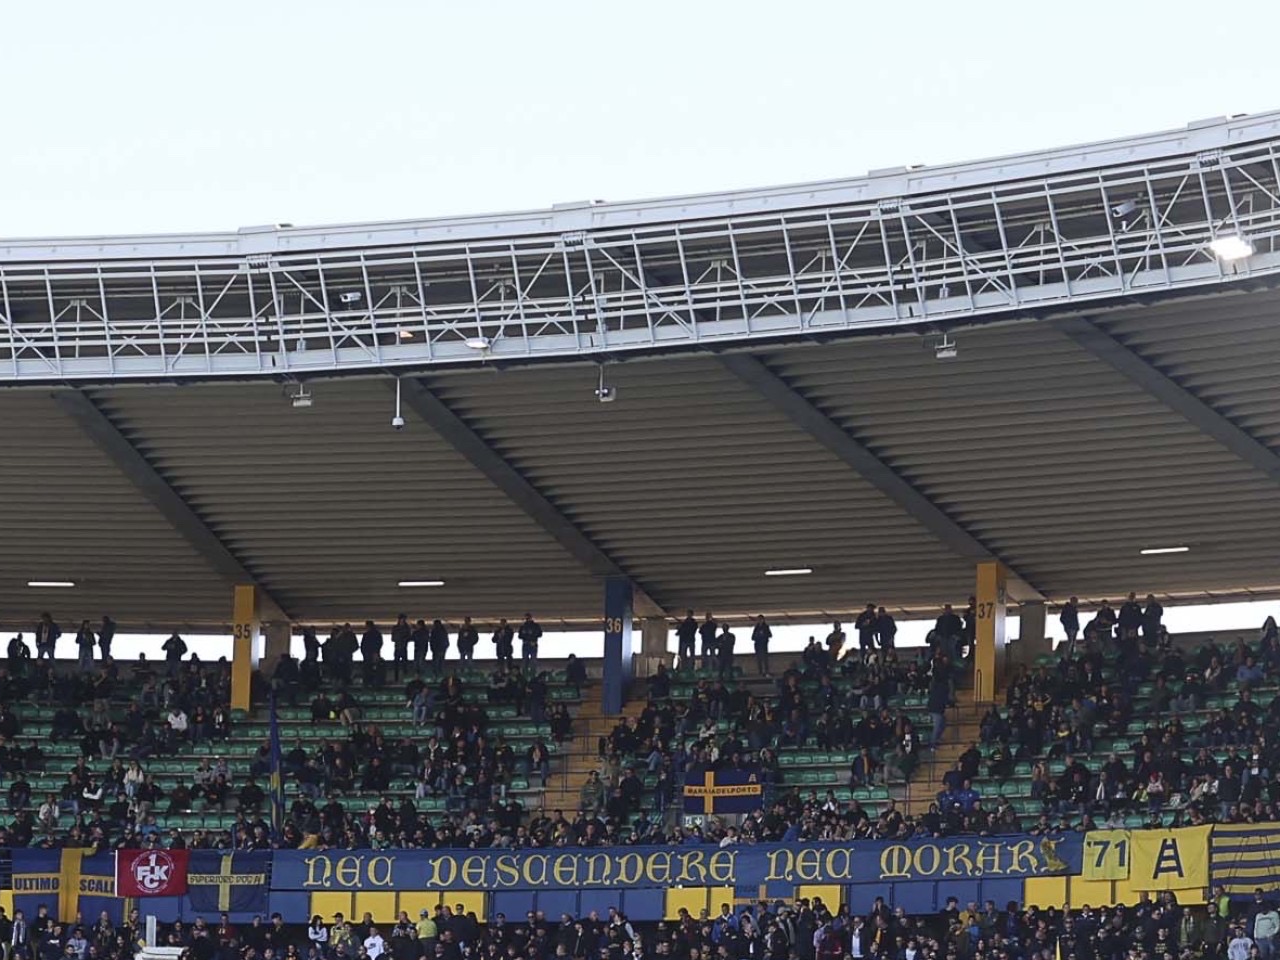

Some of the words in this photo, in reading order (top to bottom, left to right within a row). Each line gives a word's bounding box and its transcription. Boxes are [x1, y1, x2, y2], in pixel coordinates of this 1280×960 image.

[978, 602, 994, 619] 37
[235, 624, 250, 639] 35
[606, 618, 622, 633] 36
[879, 836, 1068, 880] MORAR
[14, 876, 60, 891] ULTIMO
